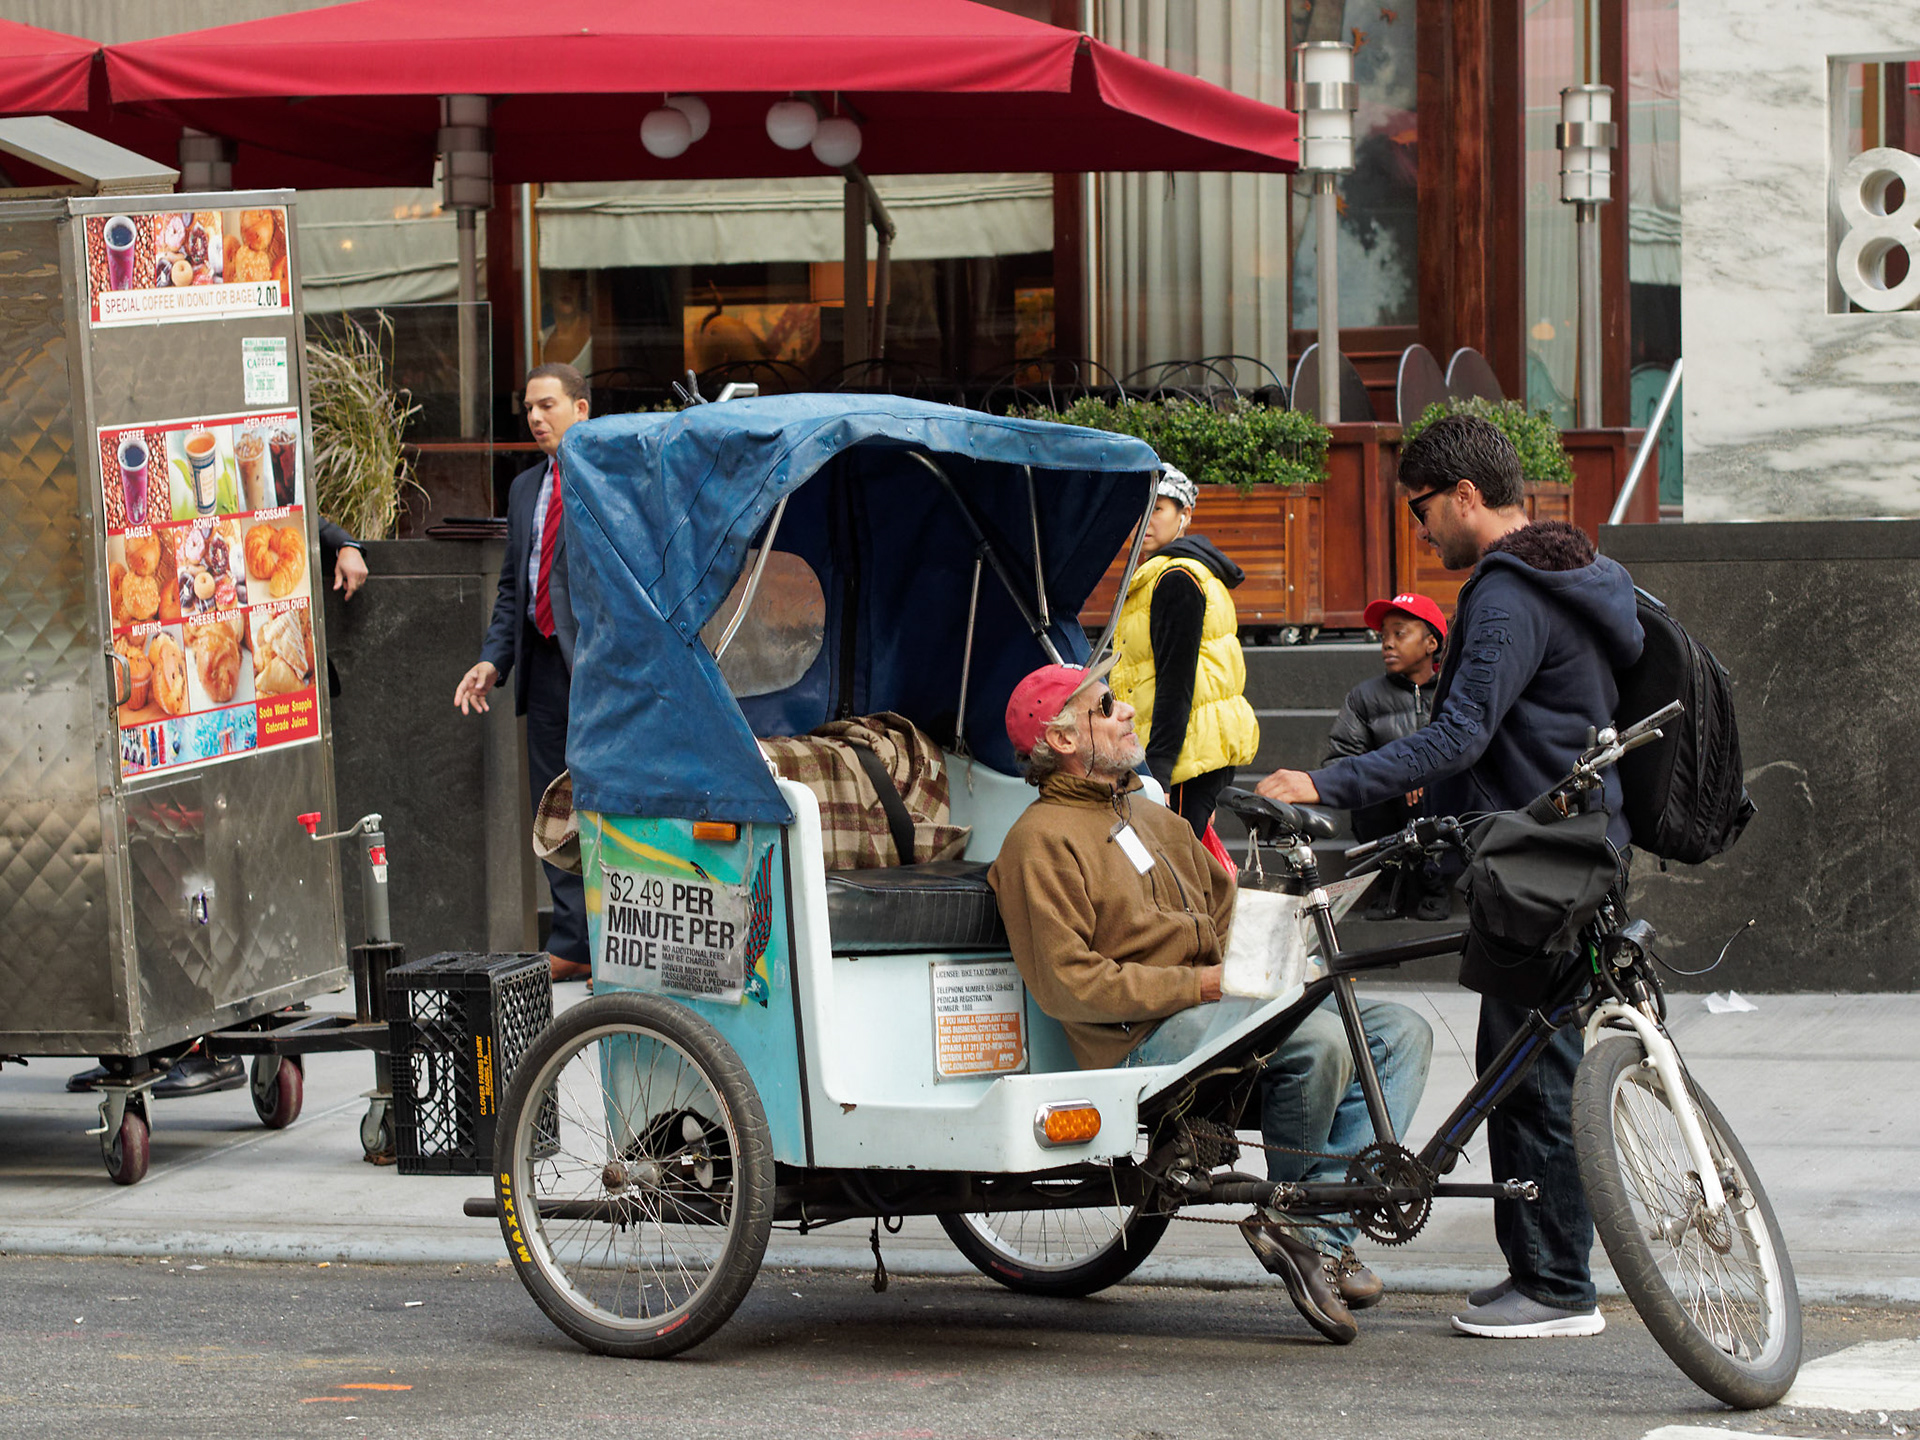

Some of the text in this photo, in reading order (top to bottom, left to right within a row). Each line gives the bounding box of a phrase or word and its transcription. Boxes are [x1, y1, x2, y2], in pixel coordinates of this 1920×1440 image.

[1836, 147, 1920, 312] 8
[105, 297, 140, 314] SPECIAL
[142, 294, 174, 311] COFFEE
[215, 290, 227, 305] OR
[229, 288, 257, 304] BAGEL
[256, 285, 278, 307] 2.00
[191, 424, 205, 434] TEA
[243, 415, 288, 429] ICED COFFEE
[118, 429, 145, 443] COFFEE
[254, 507, 291, 521] CROISSANT
[192, 516, 220, 529] DONUTS
[125, 525, 152, 539] BAGELS
[252, 598, 308, 614] APPLE TURN OVER
[188, 609, 241, 627] CHEESE DANISH
[131, 621, 162, 637] MUFFINS
[259, 699, 312, 719] Soda Water Snapple
[265, 717, 308, 734] Gatorade Juices
[610, 872, 714, 916] $2.49 PER
[608, 905, 735, 950] MINUTE PER
[605, 935, 657, 970] RIDE
[662, 944, 725, 960] NO ADDITIONAL FEES
[662, 953, 717, 968] MAY BE CHARGED.
[661, 962, 719, 978] DRIVER MUST GIVE
[961, 969, 973, 977] BIKE
[984, 967, 1008, 976] COMPANY
[661, 971, 736, 989] PASSENGERS A PEDICAB
[661, 979, 703, 993] INFORMATION
[937, 985, 964, 994] TELEPHONE
[937, 994, 993, 1004] PEDICAB REGISTRATION
[945, 1016, 956, 1025] YOU
[956, 1016, 970, 1024] HAVE
[970, 1015, 975, 1023] A
[975, 1014, 1000, 1023] COMPLAINT
[1001, 1014, 1016, 1022] ABOUT
[940, 1025, 951, 1034] THIS
[978, 1023, 1000, 1032] CONTACT
[940, 1032, 1017, 1043] NYC DEPARTMENT OF CONSUMER
[940, 1043, 962, 1052] AFFAIRS
[962, 1043, 970, 1051] AT
[999, 1053, 1014, 1062] NYC
[476, 1035, 487, 1116] CLOVER FARMS DAIRY
[500, 1172, 532, 1263] MAXXIS
